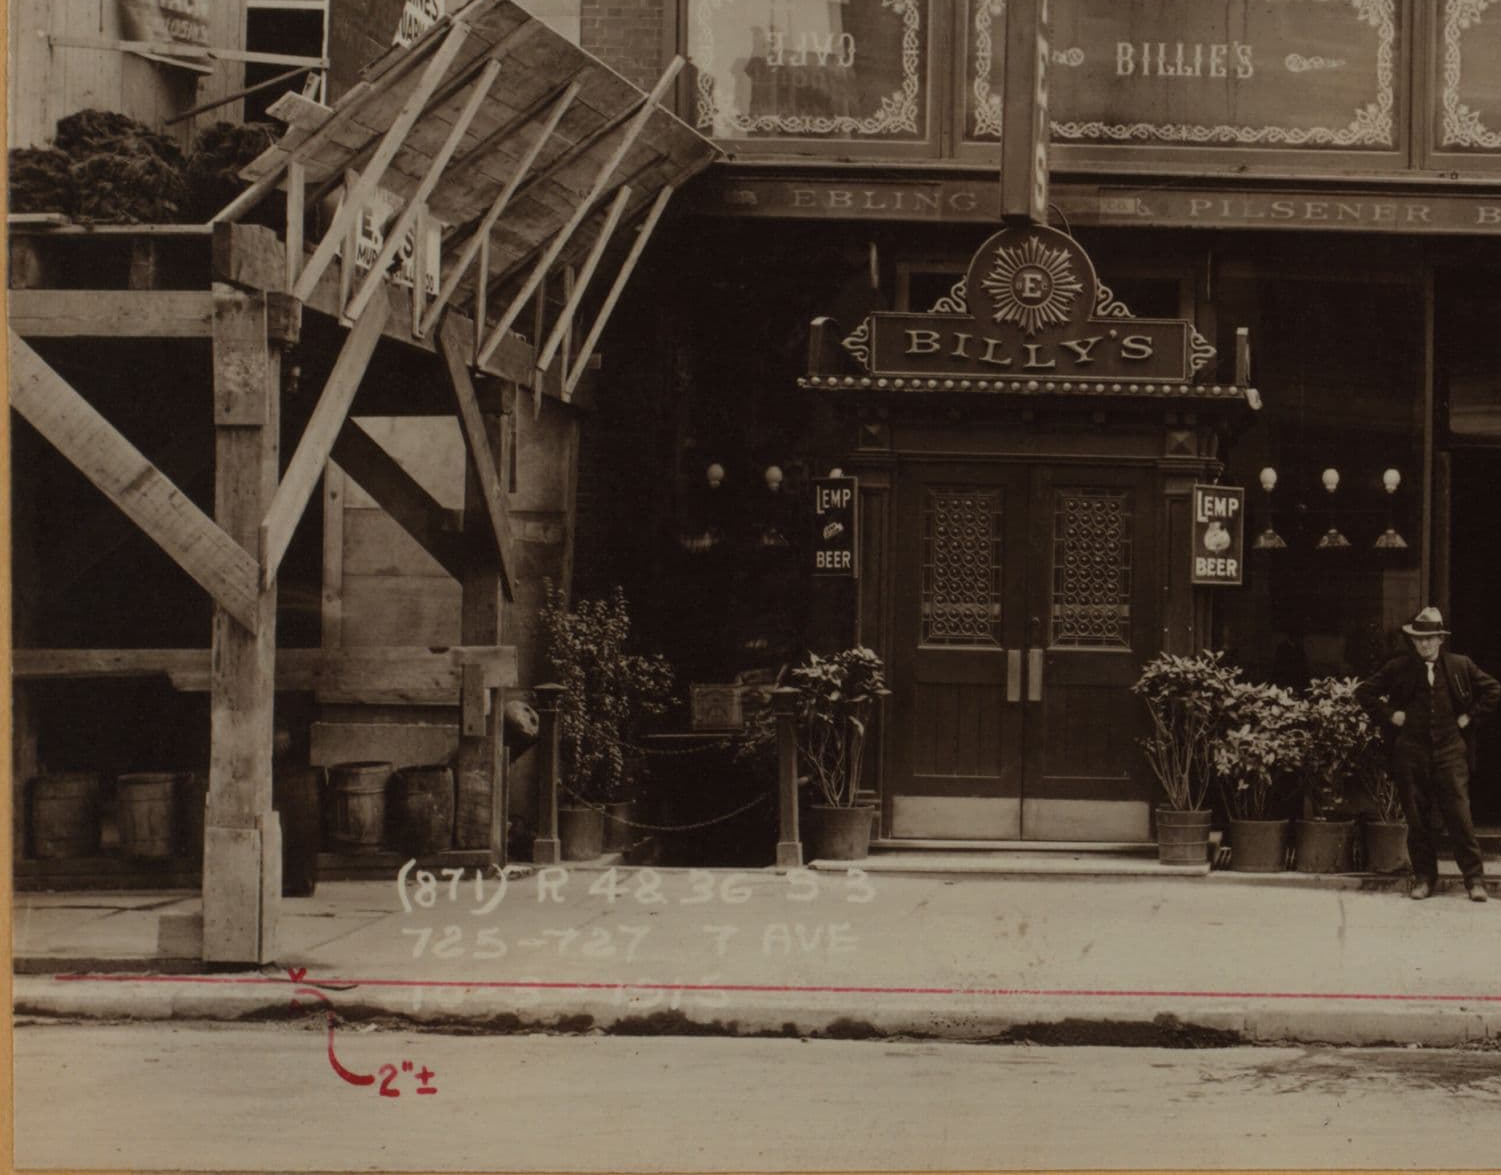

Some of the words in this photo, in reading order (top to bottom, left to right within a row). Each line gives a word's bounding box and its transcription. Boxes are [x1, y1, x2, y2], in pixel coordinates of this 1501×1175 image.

[791, 189, 978, 213] EBLING
[1189, 198, 1433, 223] PILSENER
[903, 328, 1155, 369] BILLY'S
[816, 484, 852, 516] LEMP
[1195, 489, 1240, 524] LEMP
[816, 550, 852, 570] BEER
[1195, 557, 1238, 577] BEER
